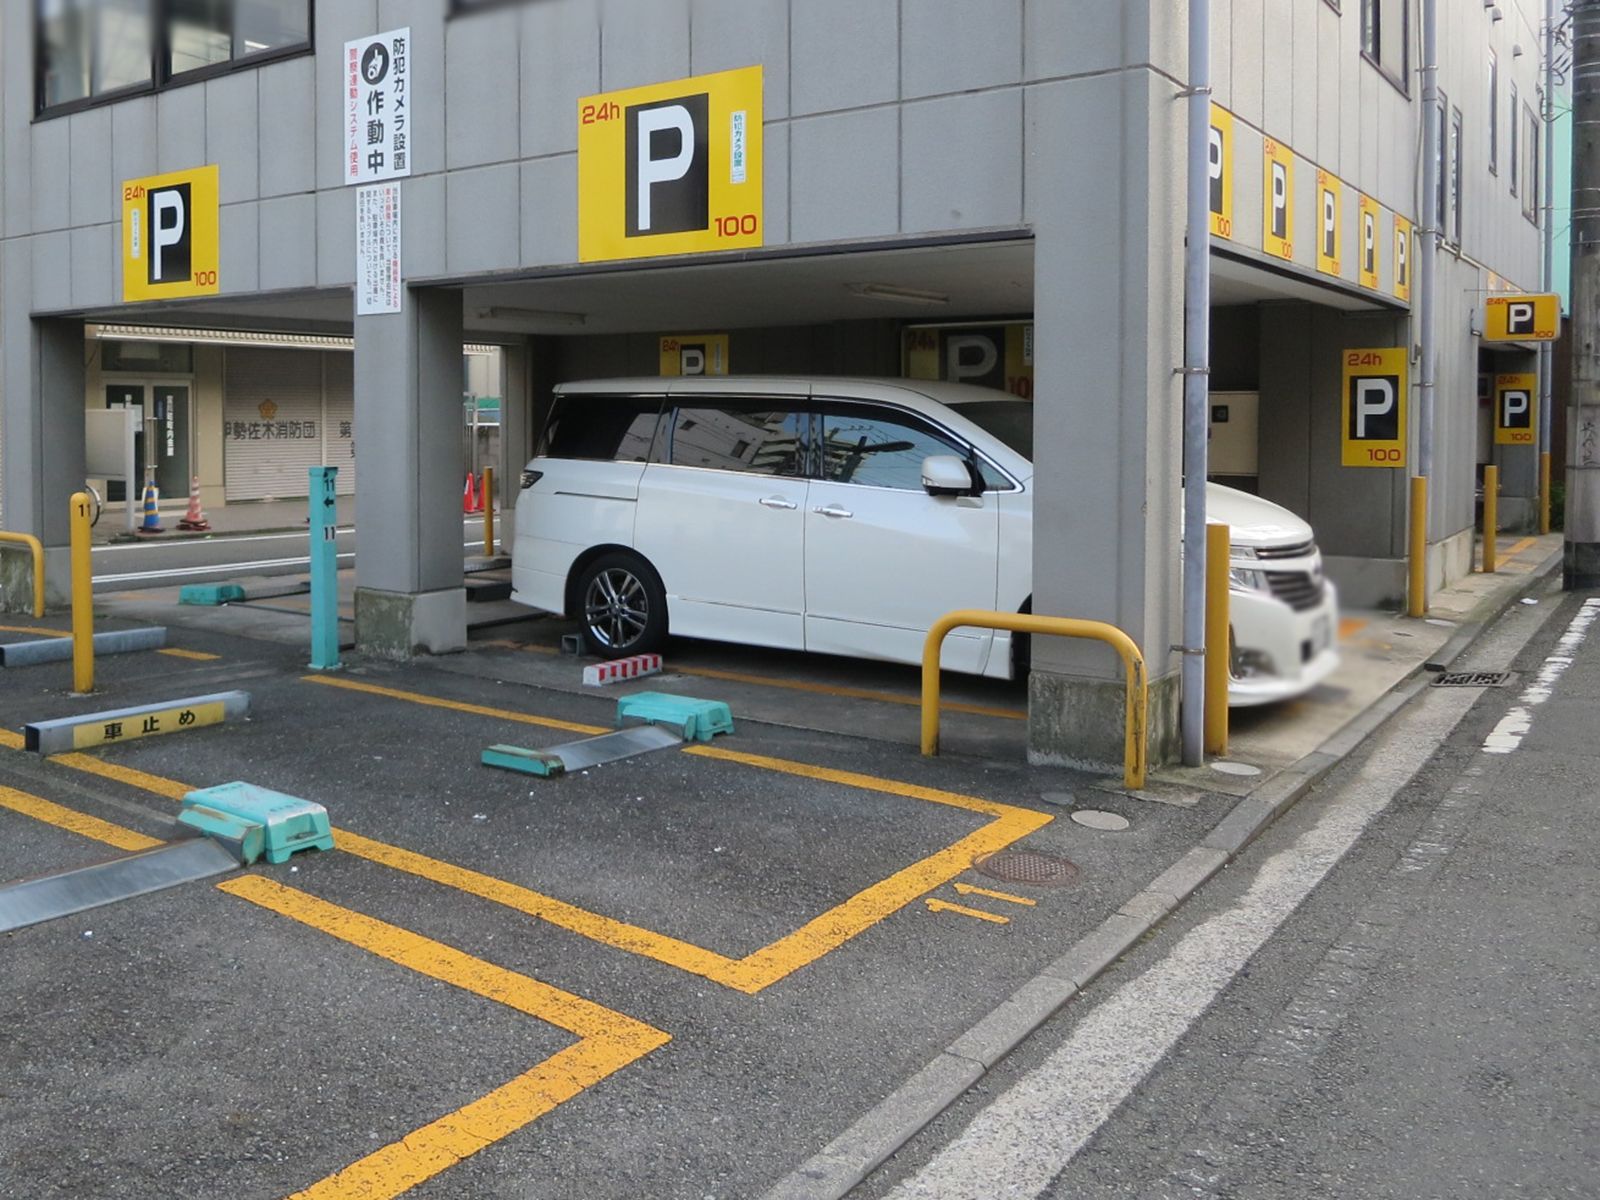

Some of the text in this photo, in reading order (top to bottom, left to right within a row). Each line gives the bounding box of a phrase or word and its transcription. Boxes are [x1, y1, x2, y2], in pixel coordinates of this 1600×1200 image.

[393, 37, 406, 171] 防犯カメラ設置
[582, 101, 620, 124] 24h
[367, 89, 384, 174] 作動中
[1265, 139, 1276, 158] 24h
[638, 104, 694, 231] P
[125, 186, 146, 201] 24h
[1272, 160, 1286, 235] P
[715, 214, 757, 237] 100
[1216, 216, 1231, 237] 100
[1323, 189, 1335, 254] P
[153, 189, 184, 280] P
[1365, 212, 1374, 271] P
[1398, 230, 1406, 284] P
[194, 270, 217, 286] 100
[1509, 303, 1533, 333] P
[1534, 330, 1555, 338] 100
[682, 349, 704, 376] P
[947, 335, 998, 383] P
[1348, 352, 1382, 366] 24h
[1498, 375, 1521, 385] 24h
[1356, 378, 1394, 438] P
[1504, 391, 1527, 427] P
[1510, 433, 1532, 441] 100
[1367, 448, 1401, 462] 100
[324, 478, 334, 491] 11
[78, 503, 91, 517] 11
[324, 526, 335, 540] 11
[104, 710, 196, 740] 車止め
